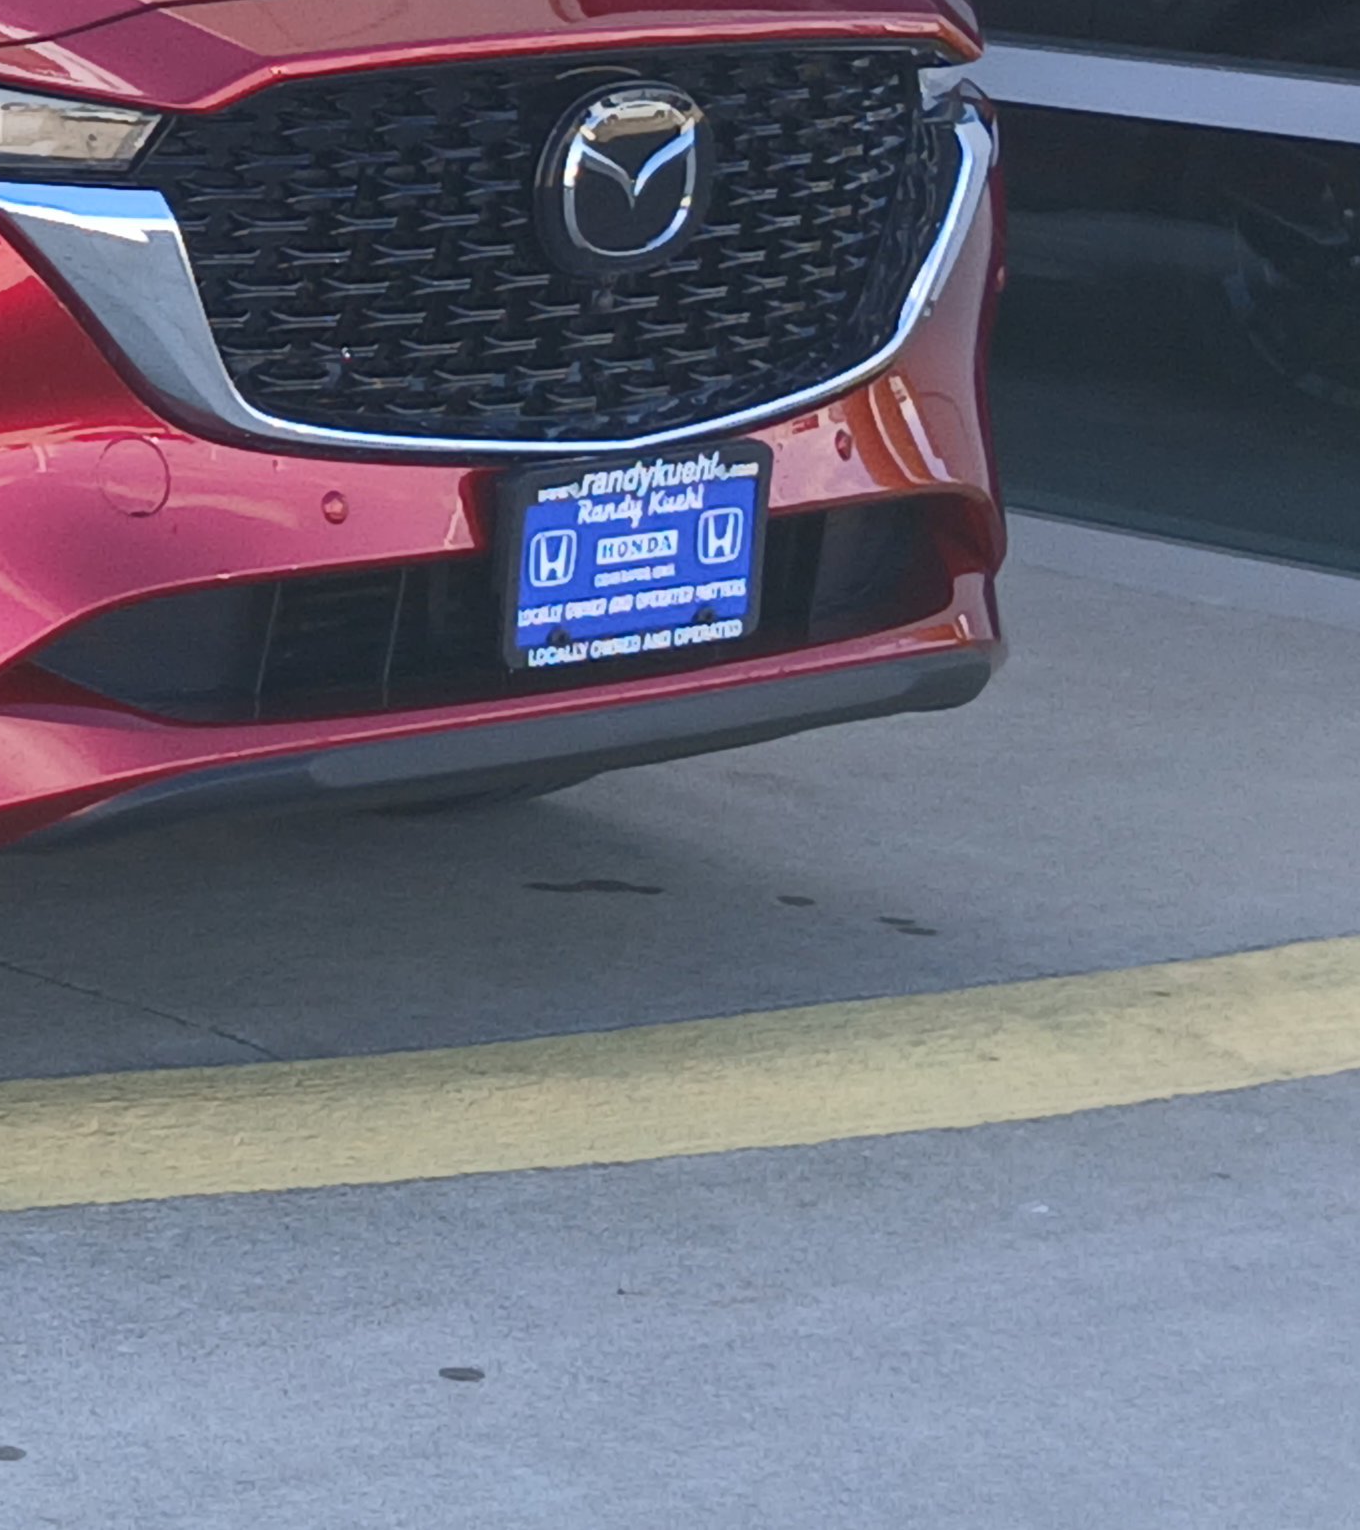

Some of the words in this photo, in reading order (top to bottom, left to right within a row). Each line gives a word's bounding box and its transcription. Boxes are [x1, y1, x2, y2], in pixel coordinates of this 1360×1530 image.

[577, 494, 643, 528] Randy
[648, 484, 704, 516] Kuehl
[601, 535, 673, 560] HONDA
[528, 641, 590, 667] LOCALLY
[590, 634, 641, 659] OWNED
[643, 629, 671, 651] AND
[674, 619, 744, 646] OPERATED
